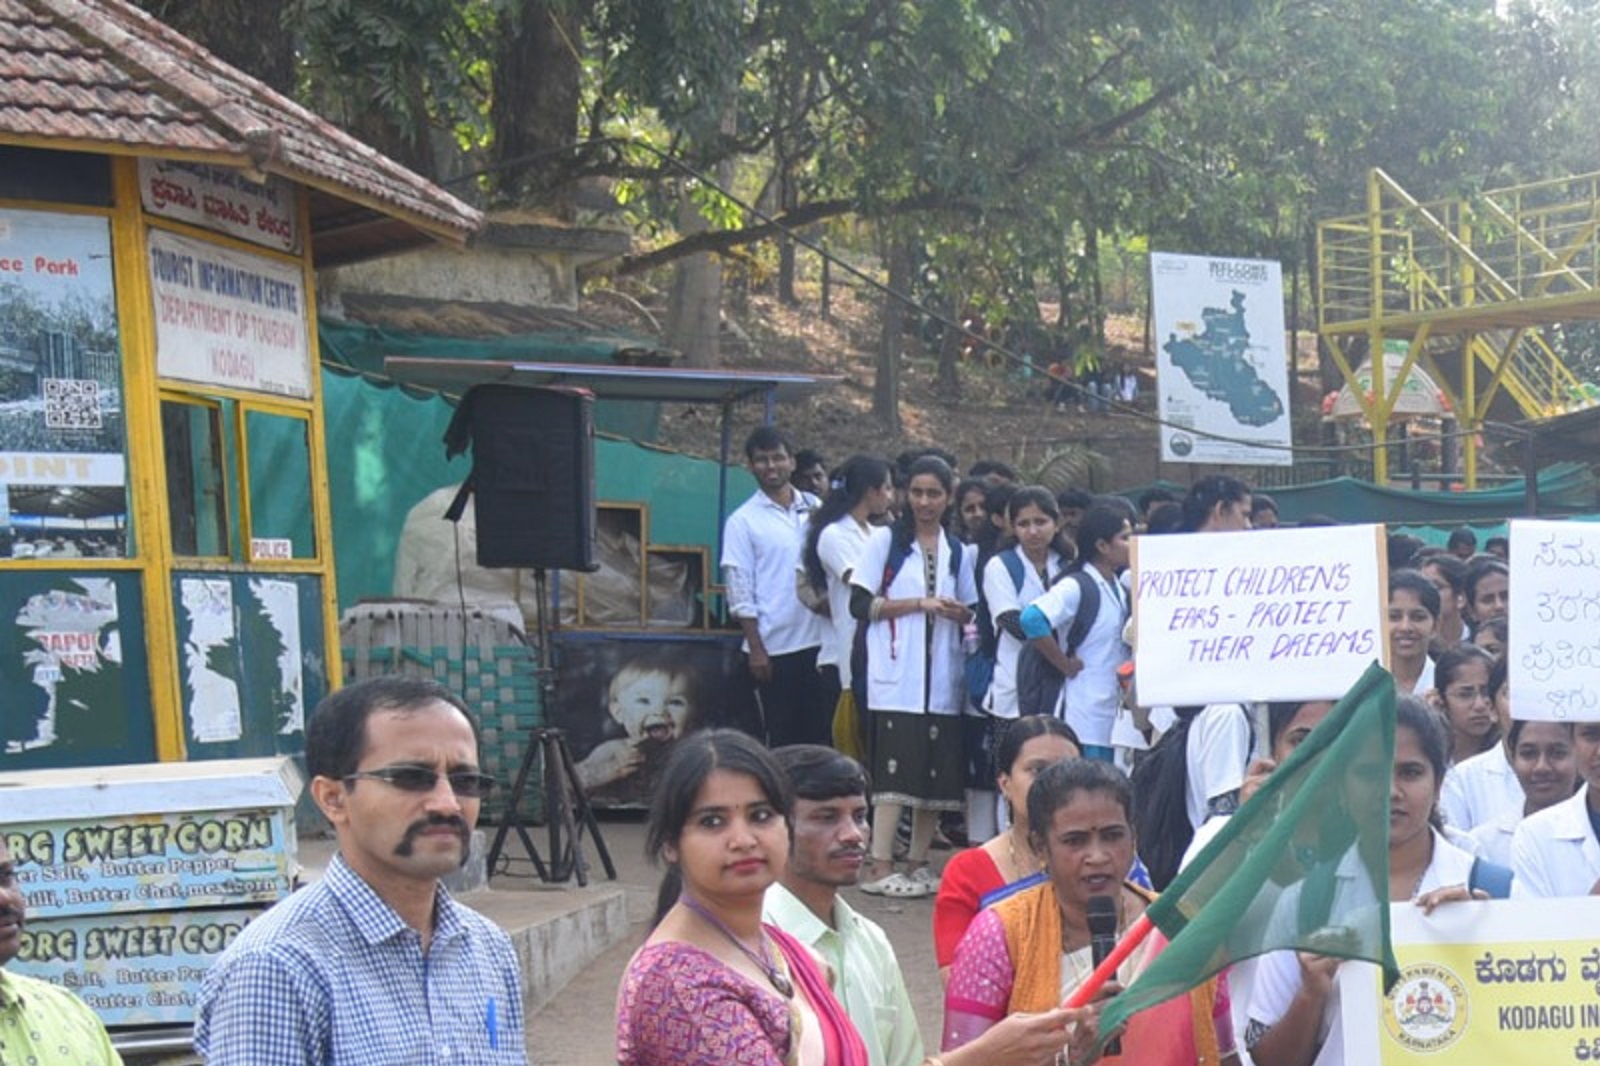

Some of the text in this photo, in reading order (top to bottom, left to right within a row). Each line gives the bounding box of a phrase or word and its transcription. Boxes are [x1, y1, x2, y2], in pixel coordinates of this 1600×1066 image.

[34, 255, 79, 277] Park
[152, 247, 298, 315] TOURIST INFORMATION CENTRE
[160, 293, 297, 350] DEPARTMENT OF TOURISM
[212, 347, 256, 382] KODAGU
[1138, 561, 1352, 600] PROTECT CHILDREN'S
[1168, 605, 1220, 631] EARS
[1247, 600, 1352, 628] PROTECT
[1188, 629, 1376, 662] THEIR DREAMS
[63, 823, 168, 863] SWEET
[175, 816, 273, 852] CORN
[102, 860, 166, 879] Butter
[169, 857, 237, 879] Pepper
[67, 886, 130, 905] Butter
[84, 924, 176, 960] SWEET
[117, 968, 175, 984] Butter
[1474, 951, 1568, 984] ಕೊಡಗು
[1499, 1004, 1575, 1030] KODAGU
[1398, 1029, 1457, 1049] KARNATAKA
